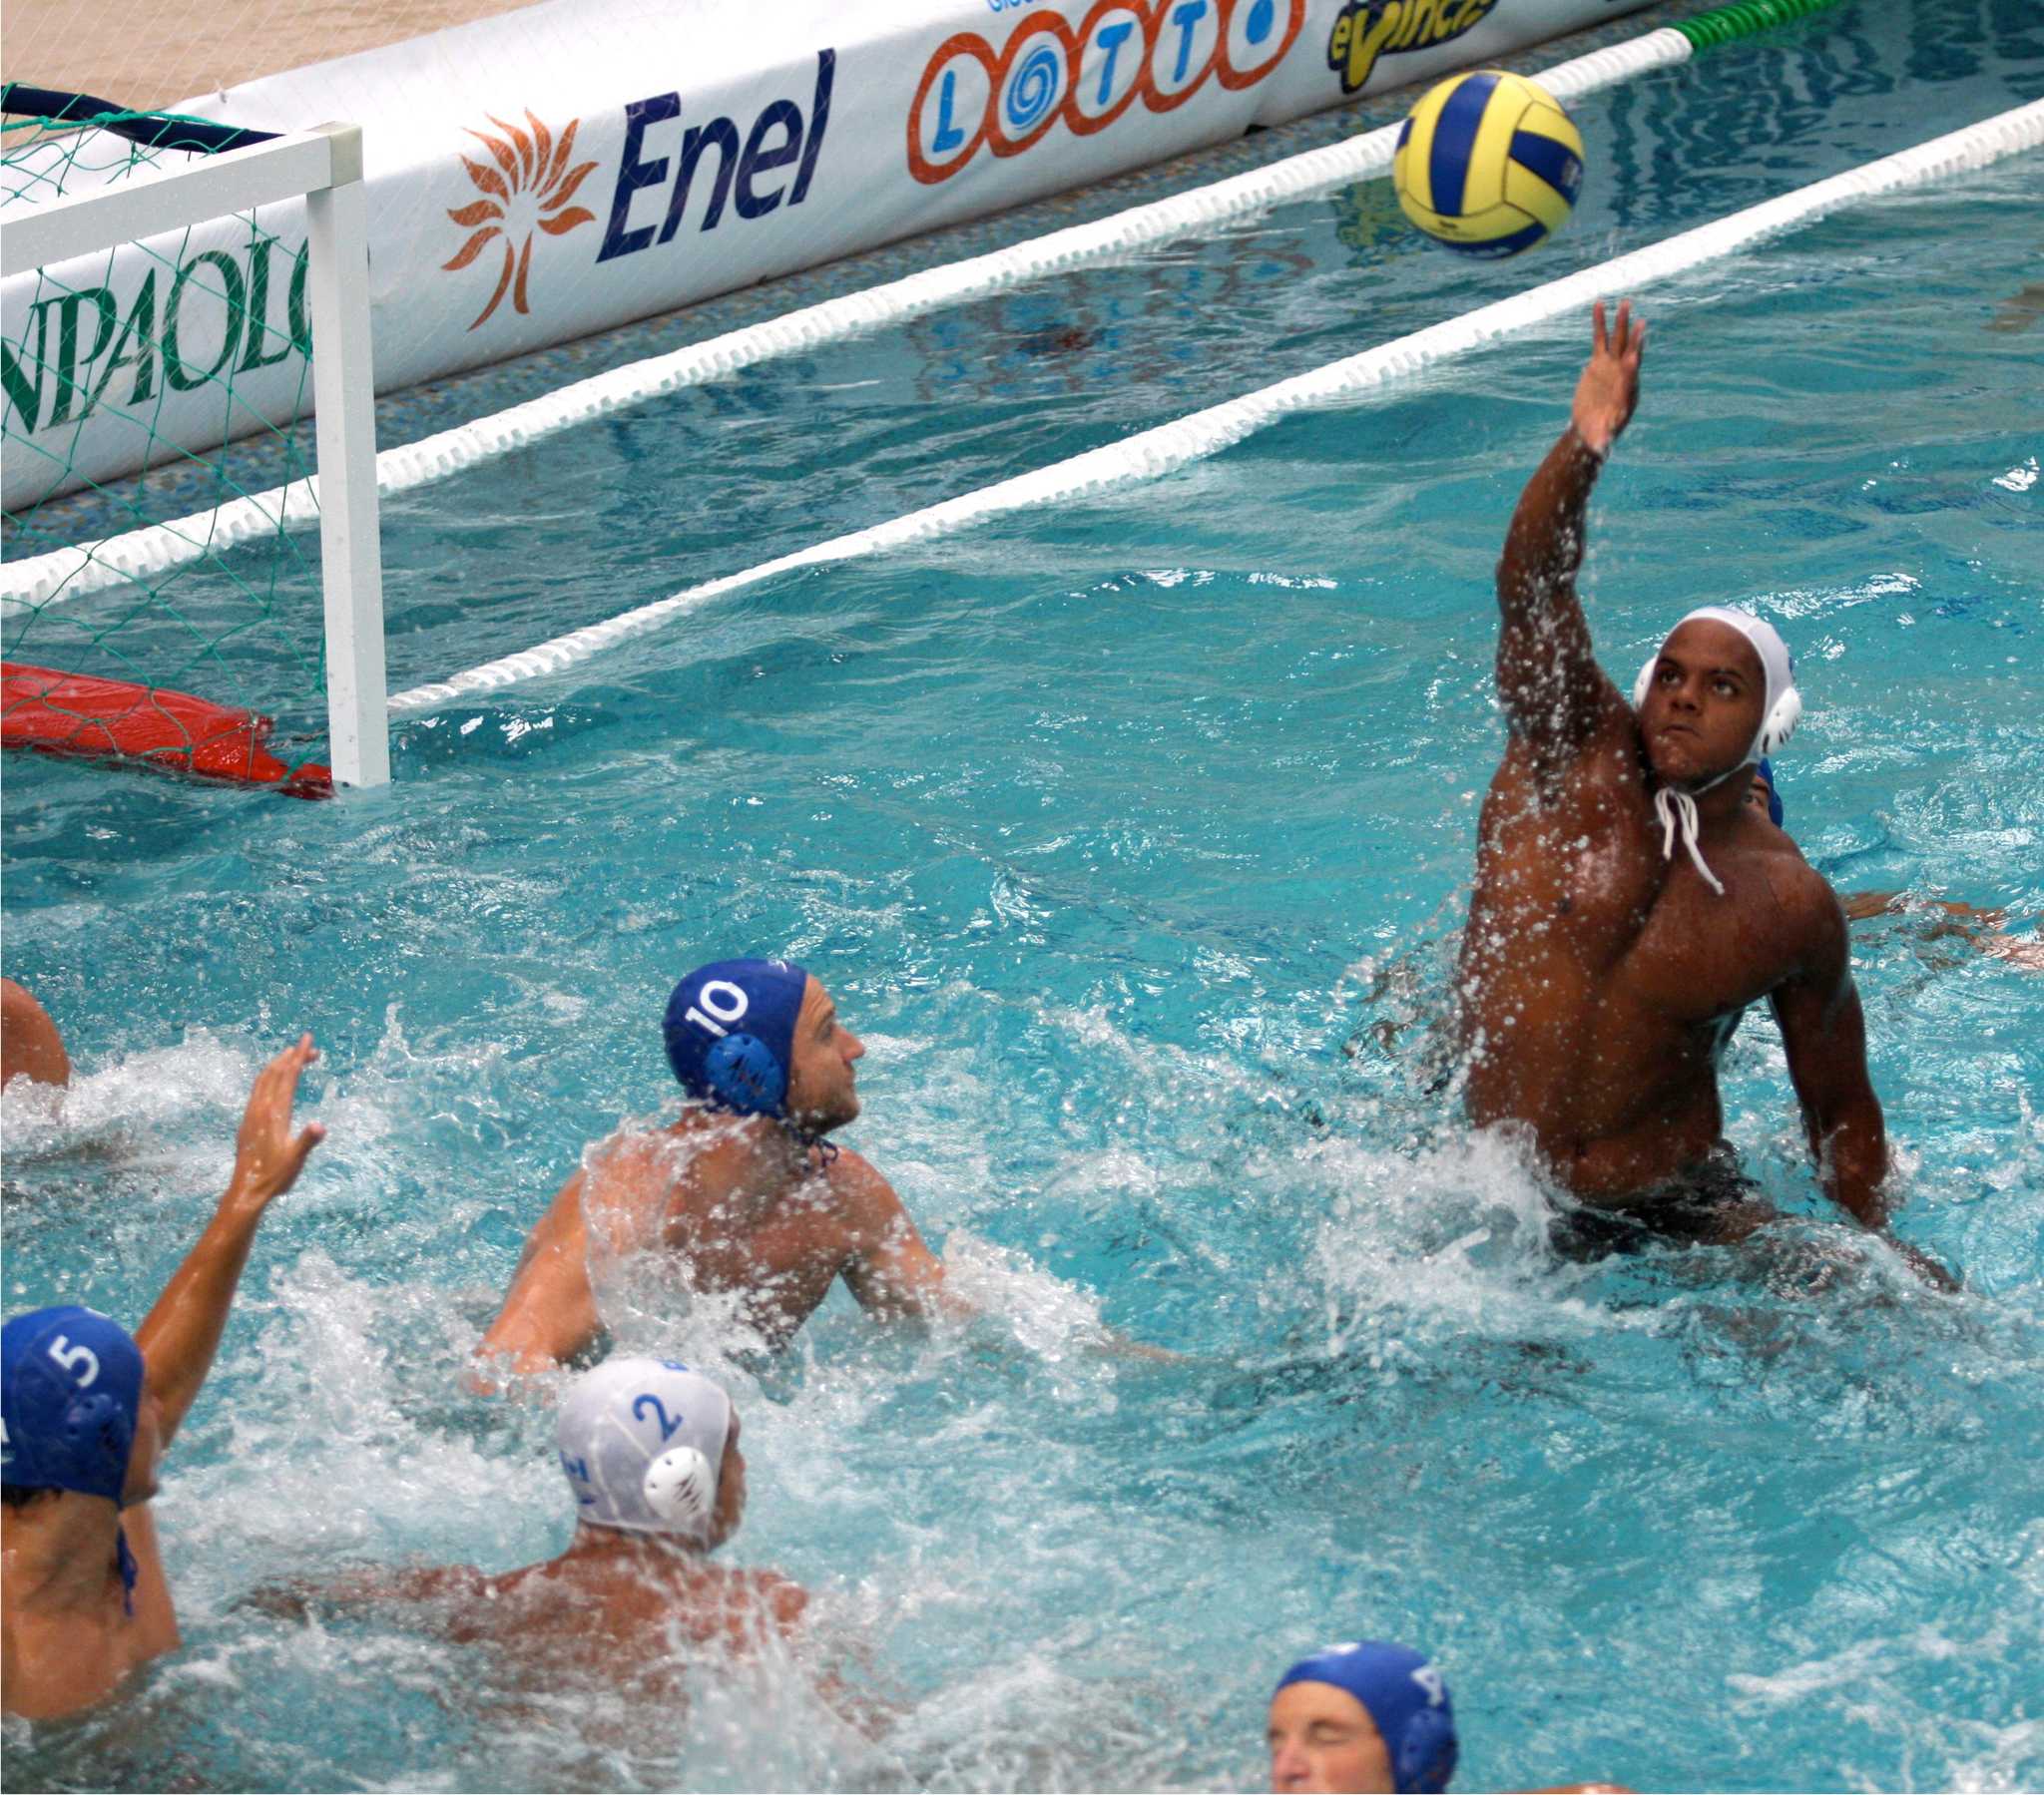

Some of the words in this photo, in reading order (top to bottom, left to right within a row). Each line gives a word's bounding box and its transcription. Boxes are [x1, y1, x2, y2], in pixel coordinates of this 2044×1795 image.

[932, 0, 1275, 153] LOTTO
[596, 47, 836, 263] Enel
[0, 236, 370, 435] NPAOL
[685, 980, 749, 1038] 10
[48, 1335, 99, 1388] 5
[633, 1393, 684, 1442] 2
